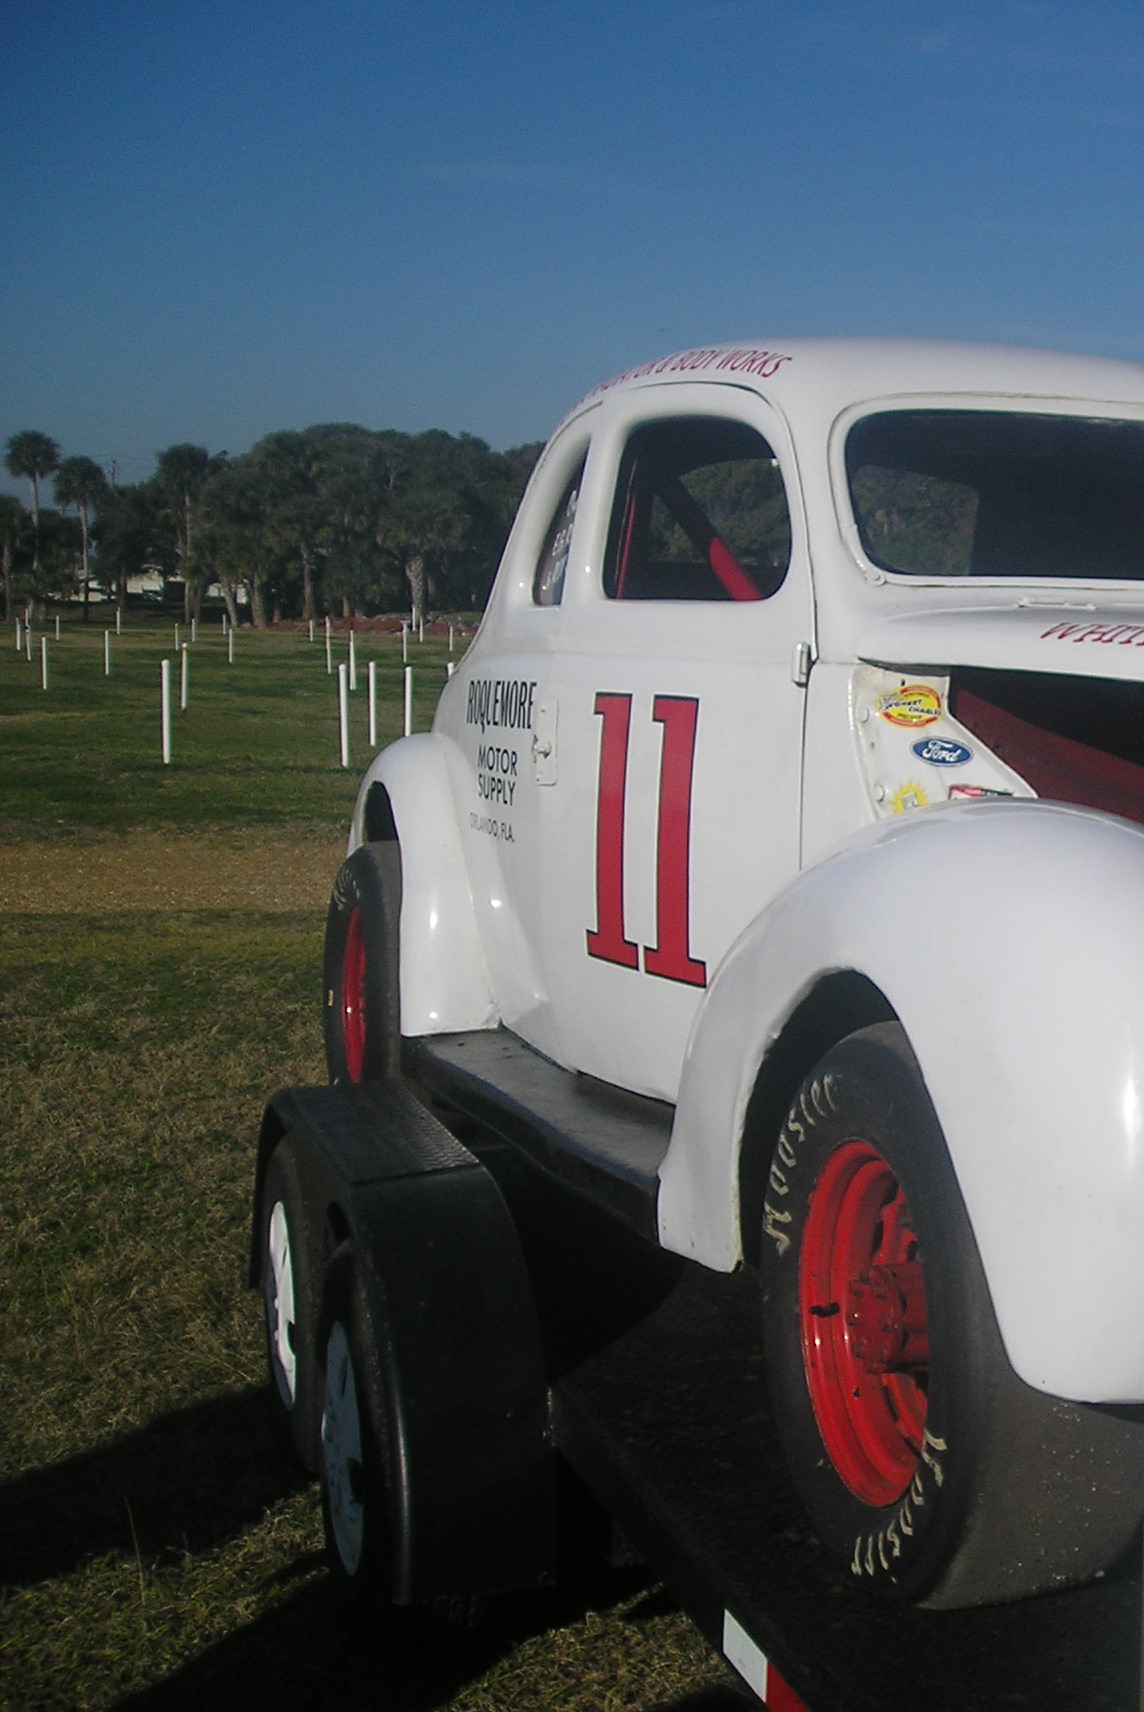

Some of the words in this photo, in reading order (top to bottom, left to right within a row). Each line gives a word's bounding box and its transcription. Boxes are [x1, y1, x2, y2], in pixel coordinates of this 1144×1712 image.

[715, 350, 793, 378] WORKS
[477, 744, 518, 776] MOTOR
[921, 738, 962, 762] Ford
[478, 773, 517, 807] SUPPLY
[585, 691, 707, 989] 11
